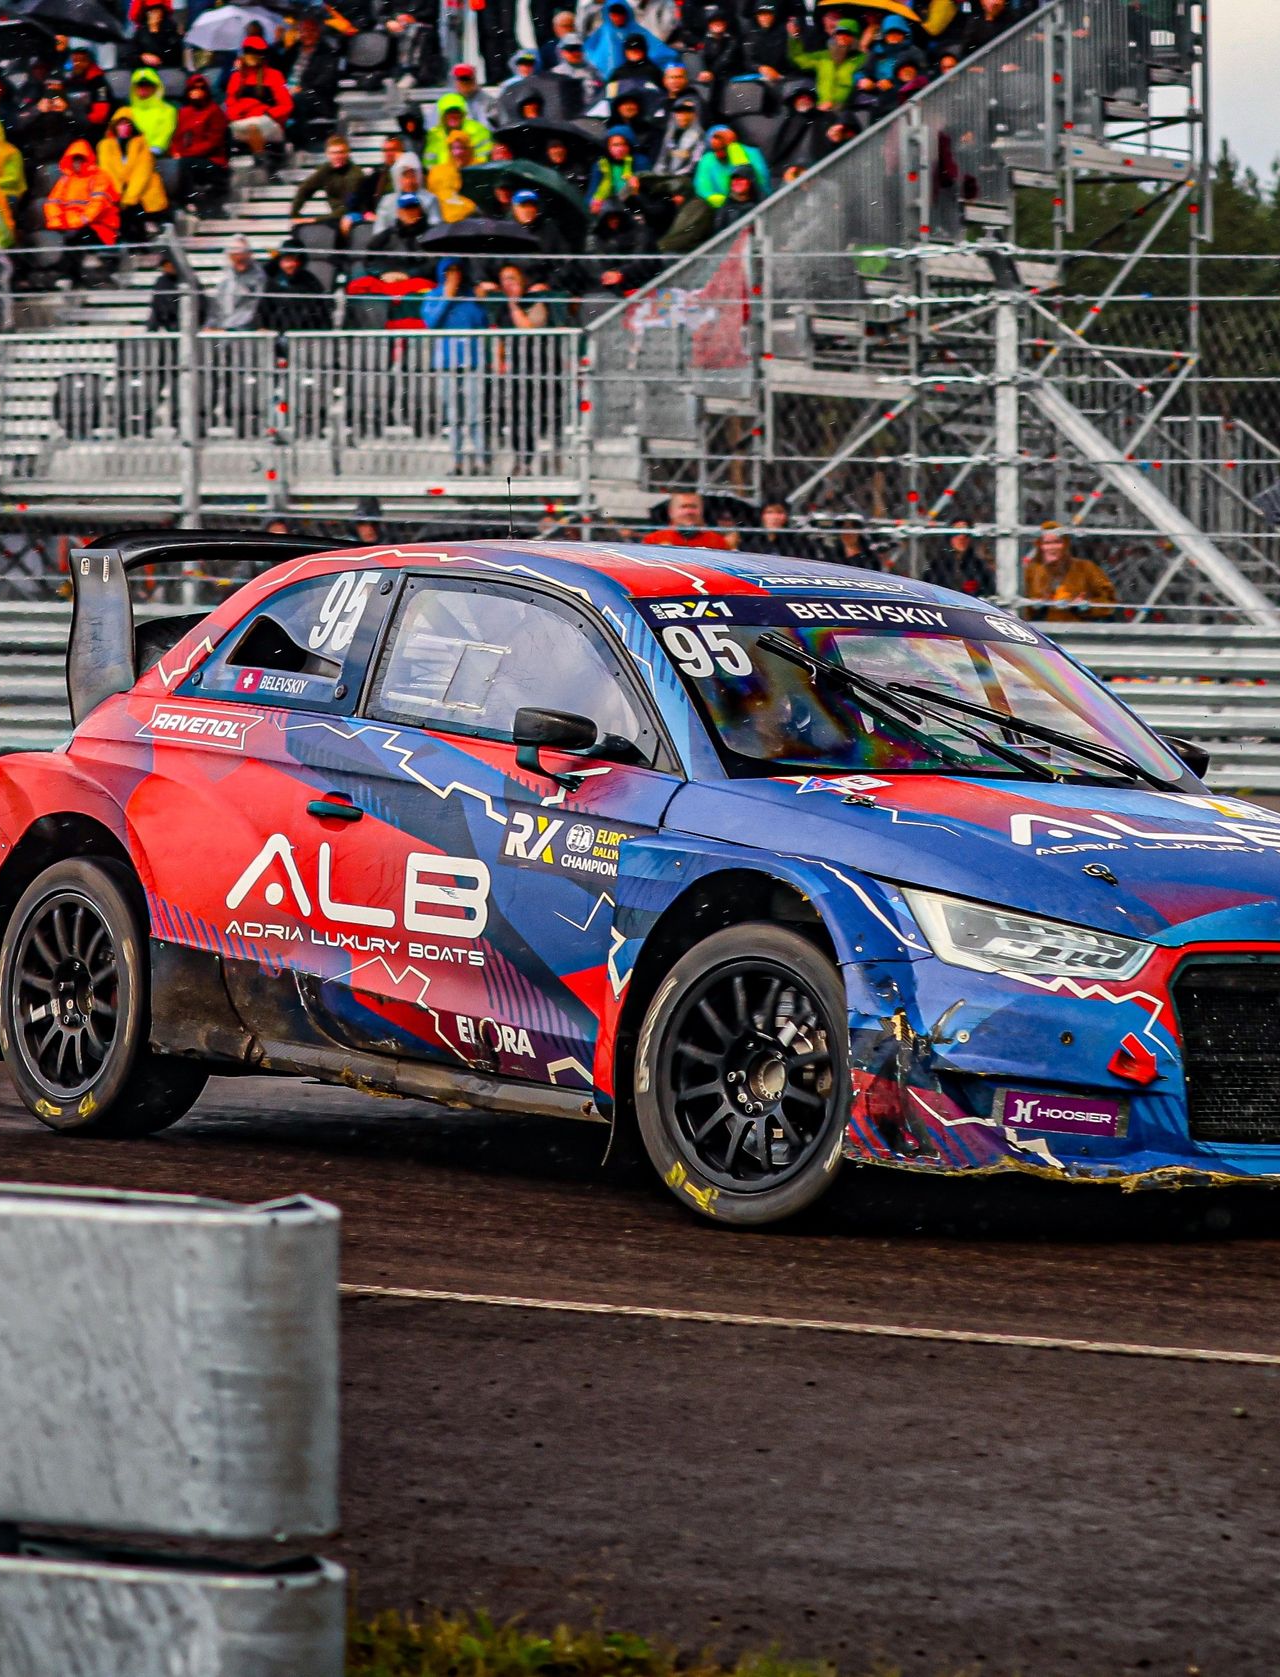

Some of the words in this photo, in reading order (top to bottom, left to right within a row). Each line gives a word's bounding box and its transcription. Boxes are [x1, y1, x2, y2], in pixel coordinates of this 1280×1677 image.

[767, 576, 897, 591] RAVENOL
[309, 570, 379, 651] 95
[659, 601, 734, 619] RX1
[785, 602, 949, 628] BELEVSKIY
[660, 625, 753, 678] 95
[259, 675, 309, 695] BELEVSKIY
[151, 713, 242, 738] RAVENOL
[504, 811, 565, 864] RX
[1035, 841, 1129, 856] ADRIA
[1133, 841, 1269, 855] LUXURY
[560, 854, 618, 877] CHAMPION
[224, 832, 492, 939] ALB
[224, 920, 304, 941] ADRIA
[310, 929, 401, 955] LUXURY
[408, 942, 486, 967] BOATS
[1037, 1107, 1113, 1124] HOOSIER
